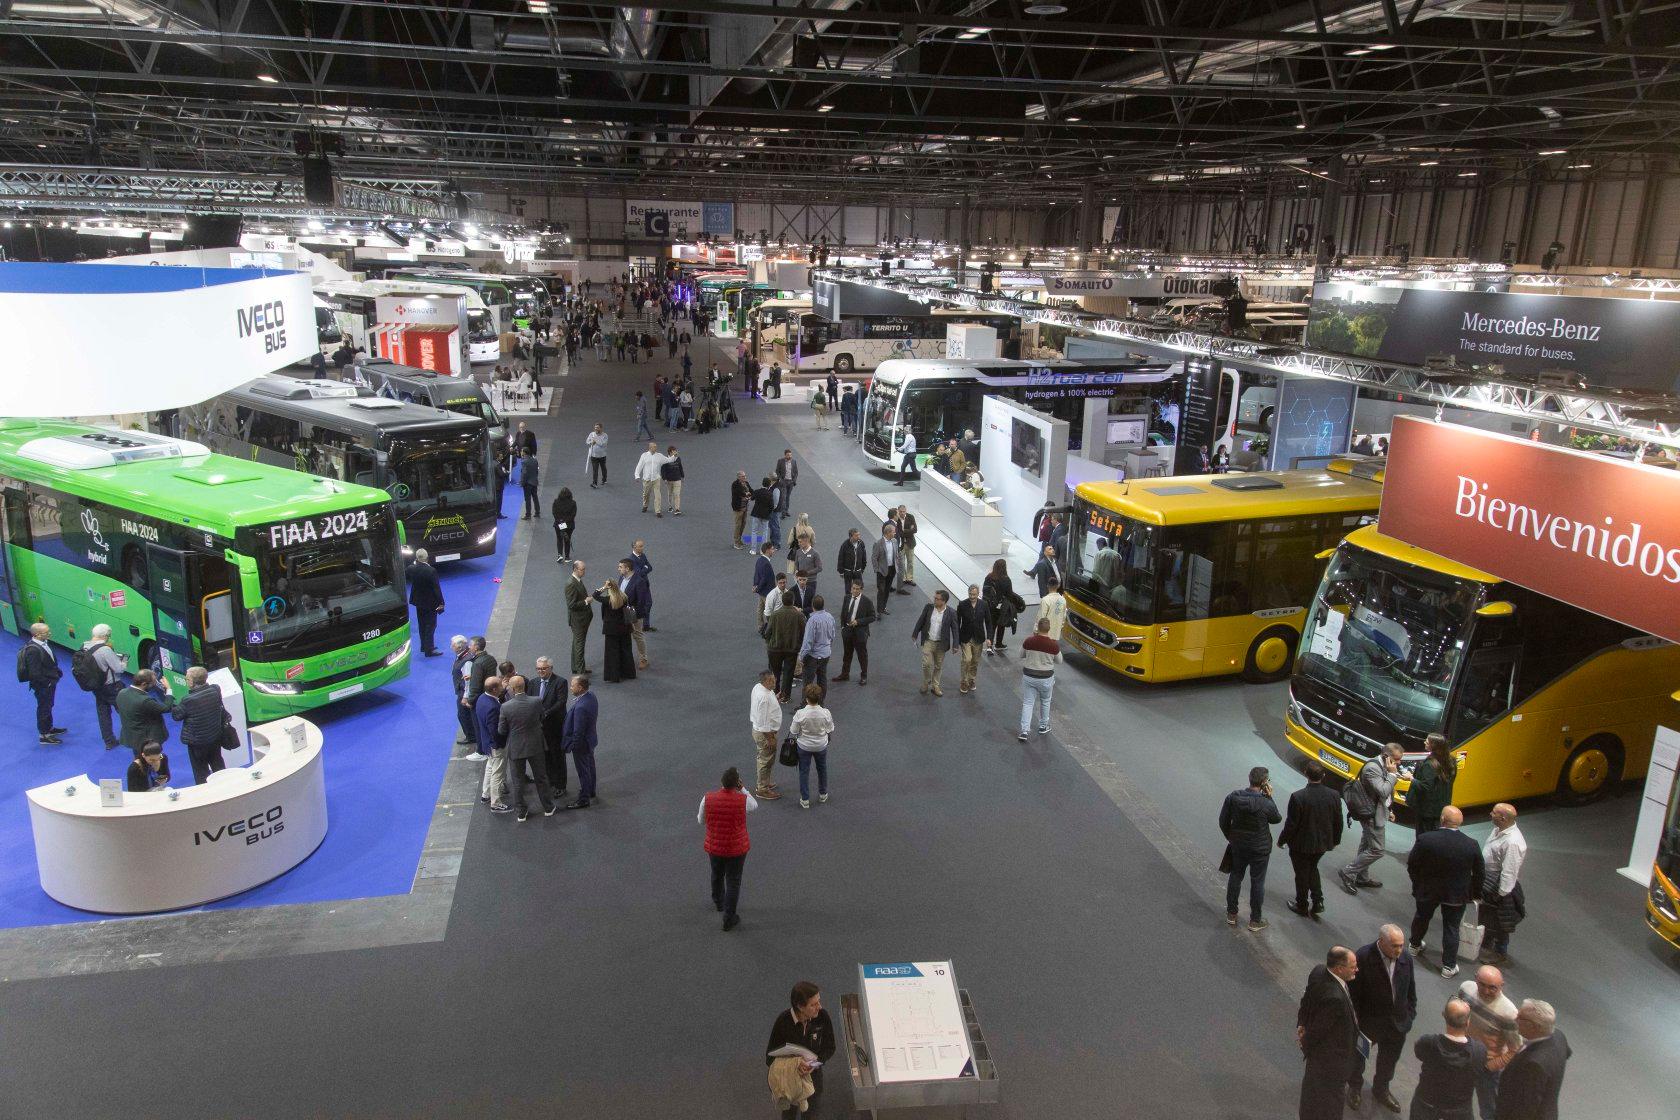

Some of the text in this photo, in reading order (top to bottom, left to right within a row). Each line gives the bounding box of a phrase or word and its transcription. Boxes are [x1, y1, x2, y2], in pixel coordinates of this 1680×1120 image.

[650, 216, 664, 233] C
[237, 300, 284, 339] IVECO
[1461, 311, 1601, 341] Mercedes-Benz
[264, 329, 287, 354] BUS
[1460, 338, 1576, 361] The standard for buses.
[1091, 373, 1124, 384] cell
[1025, 391, 1058, 399] hydrogen
[1068, 389, 1086, 397] 100%
[1087, 388, 1114, 396] electric
[120, 518, 159, 542] FIAA 2024
[270, 510, 369, 549] FIAA 2024
[1089, 510, 1123, 536] Setra
[1455, 475, 1680, 583] Bienvenidos
[429, 531, 465, 542] IVECO
[87, 550, 107, 565] hybrid
[362, 628, 381, 641] 1280
[194, 805, 282, 846] IVECO
[245, 821, 285, 846] BUS
